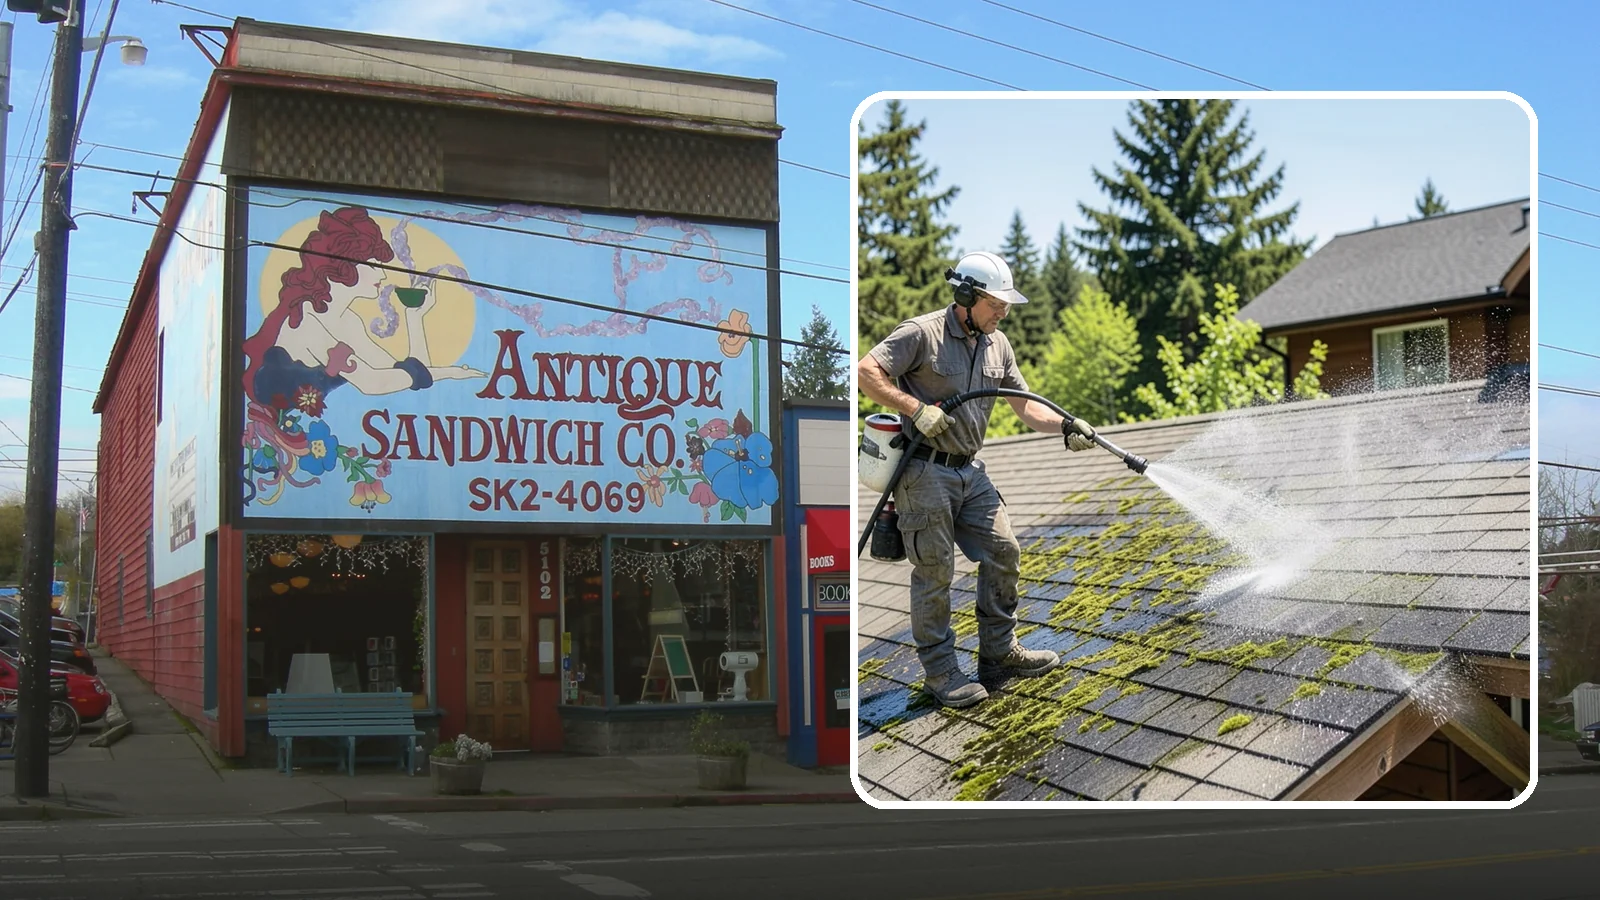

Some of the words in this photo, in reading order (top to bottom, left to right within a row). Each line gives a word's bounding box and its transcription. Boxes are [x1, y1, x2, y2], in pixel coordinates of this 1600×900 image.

[475, 329, 723, 420] ANTIQUE
[362, 408, 605, 467] SANDWICH
[617, 421, 685, 468] CO.
[468, 477, 646, 513] SK2-4069
[539, 541, 552, 600] 5102
[809, 555, 834, 569] BOOKS
